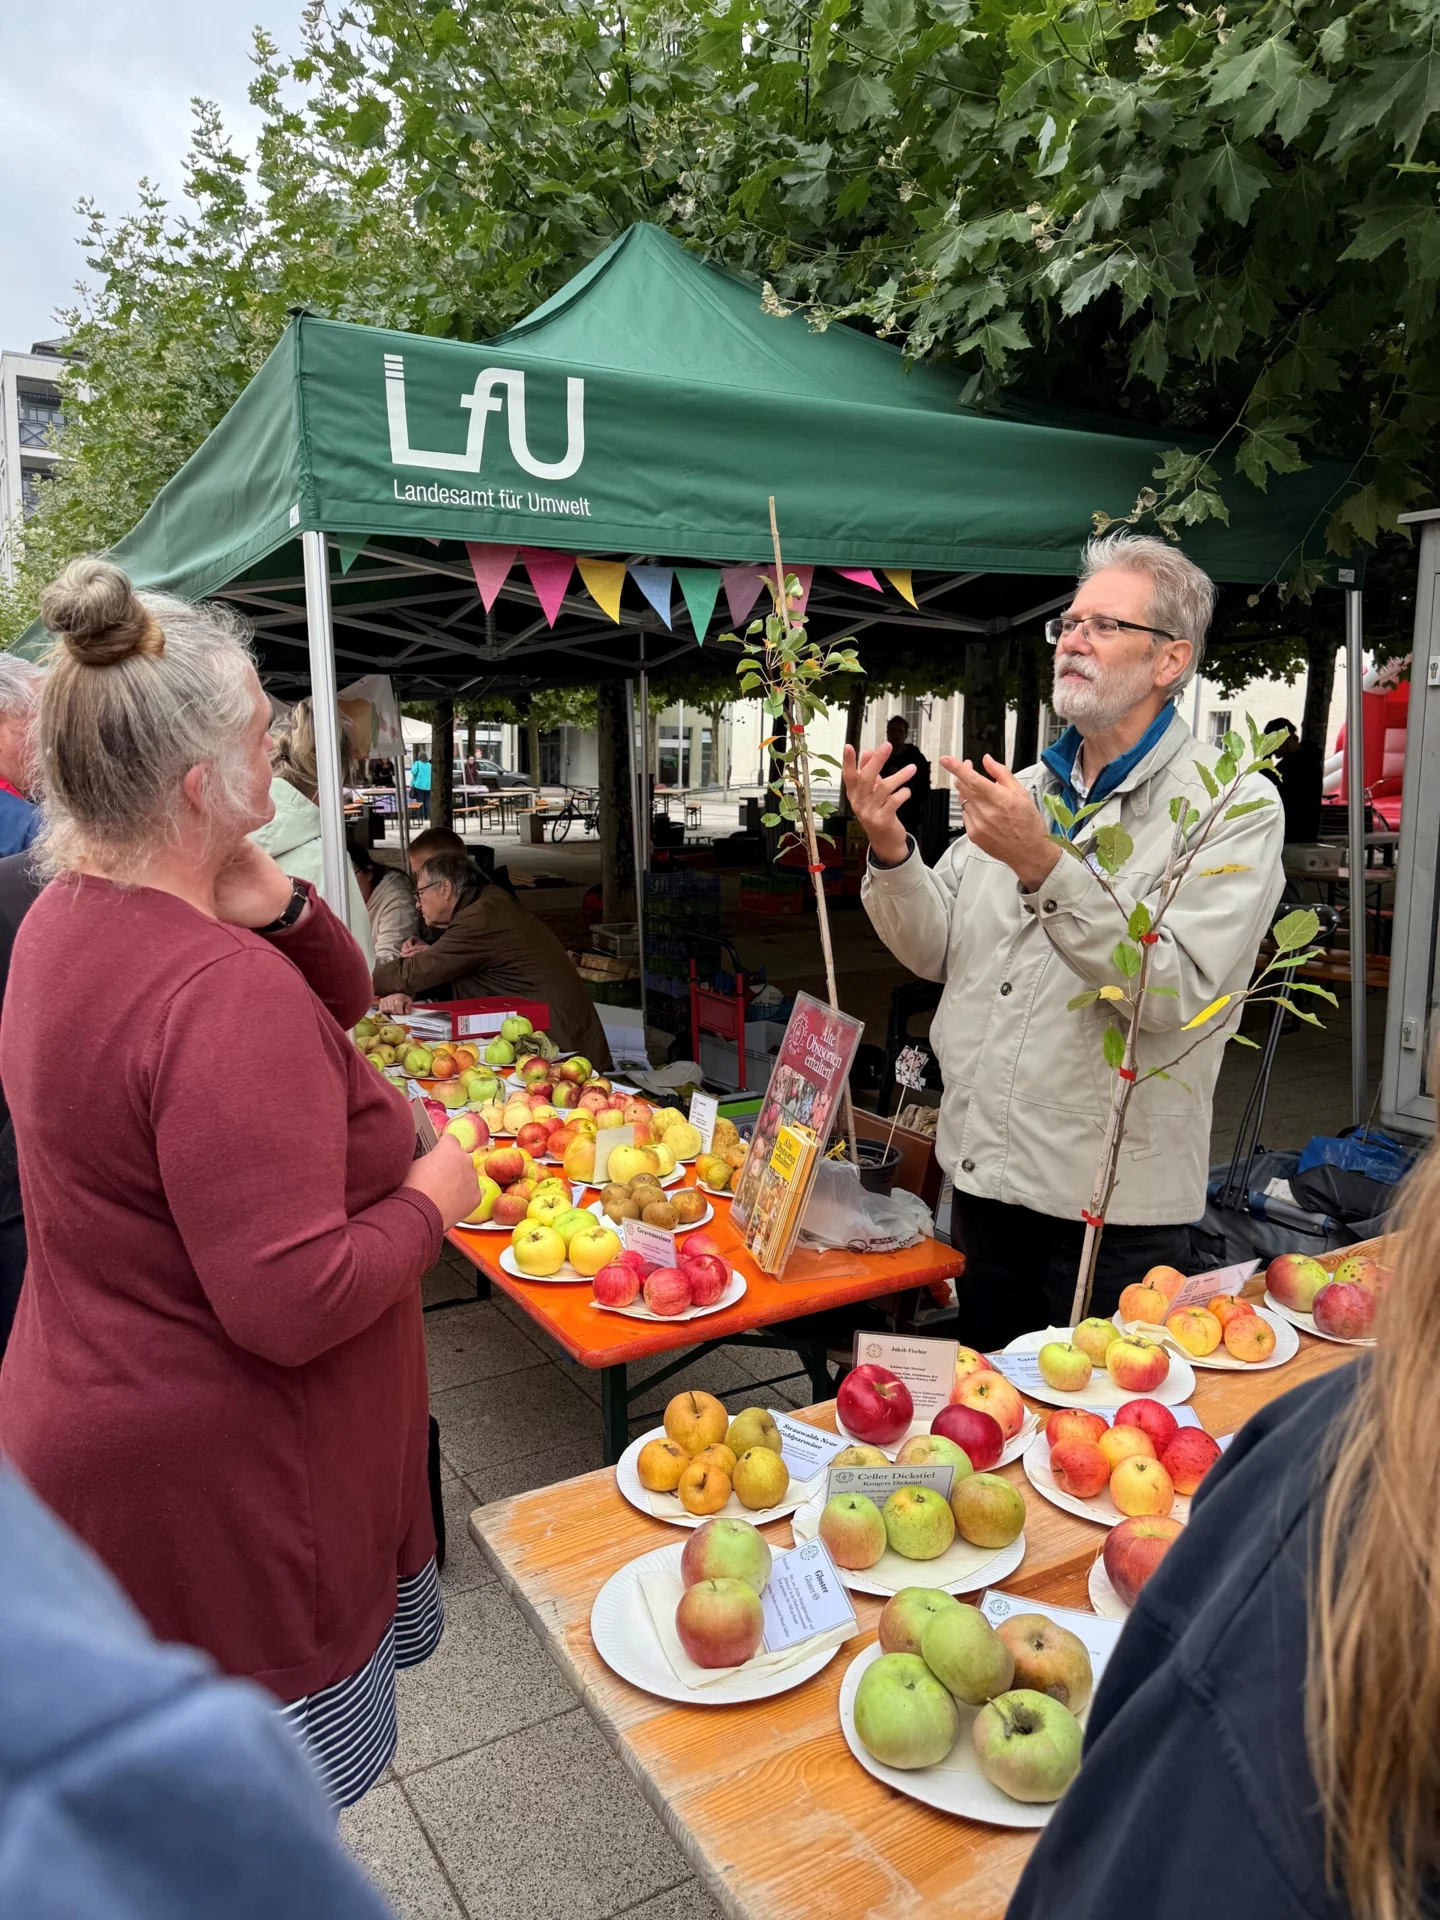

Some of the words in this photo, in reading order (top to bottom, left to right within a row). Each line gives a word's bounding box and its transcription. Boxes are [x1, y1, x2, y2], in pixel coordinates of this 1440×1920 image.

[384, 354, 585, 480] LfU
[393, 479, 495, 508] Landesamt
[499, 489, 523, 510] für
[528, 492, 592, 516] Umwelt
[820, 1025, 836, 1046] Alte
[806, 1033, 842, 1069] Obstsorten
[783, 1137, 793, 1151] Alte
[637, 1226, 671, 1243] Gravensteiner
[908, 1347, 928, 1355] Fischer
[779, 1429, 823, 1450] Goldparmäne
[782, 1423, 820, 1441] Strauwalds
[820, 1437, 838, 1447] Neue
[892, 1472, 936, 1480] Dickstiel
[804, 1574, 816, 1594] Gloster
[811, 1592, 820, 1600] 69
[815, 1570, 829, 1593] Gloster
